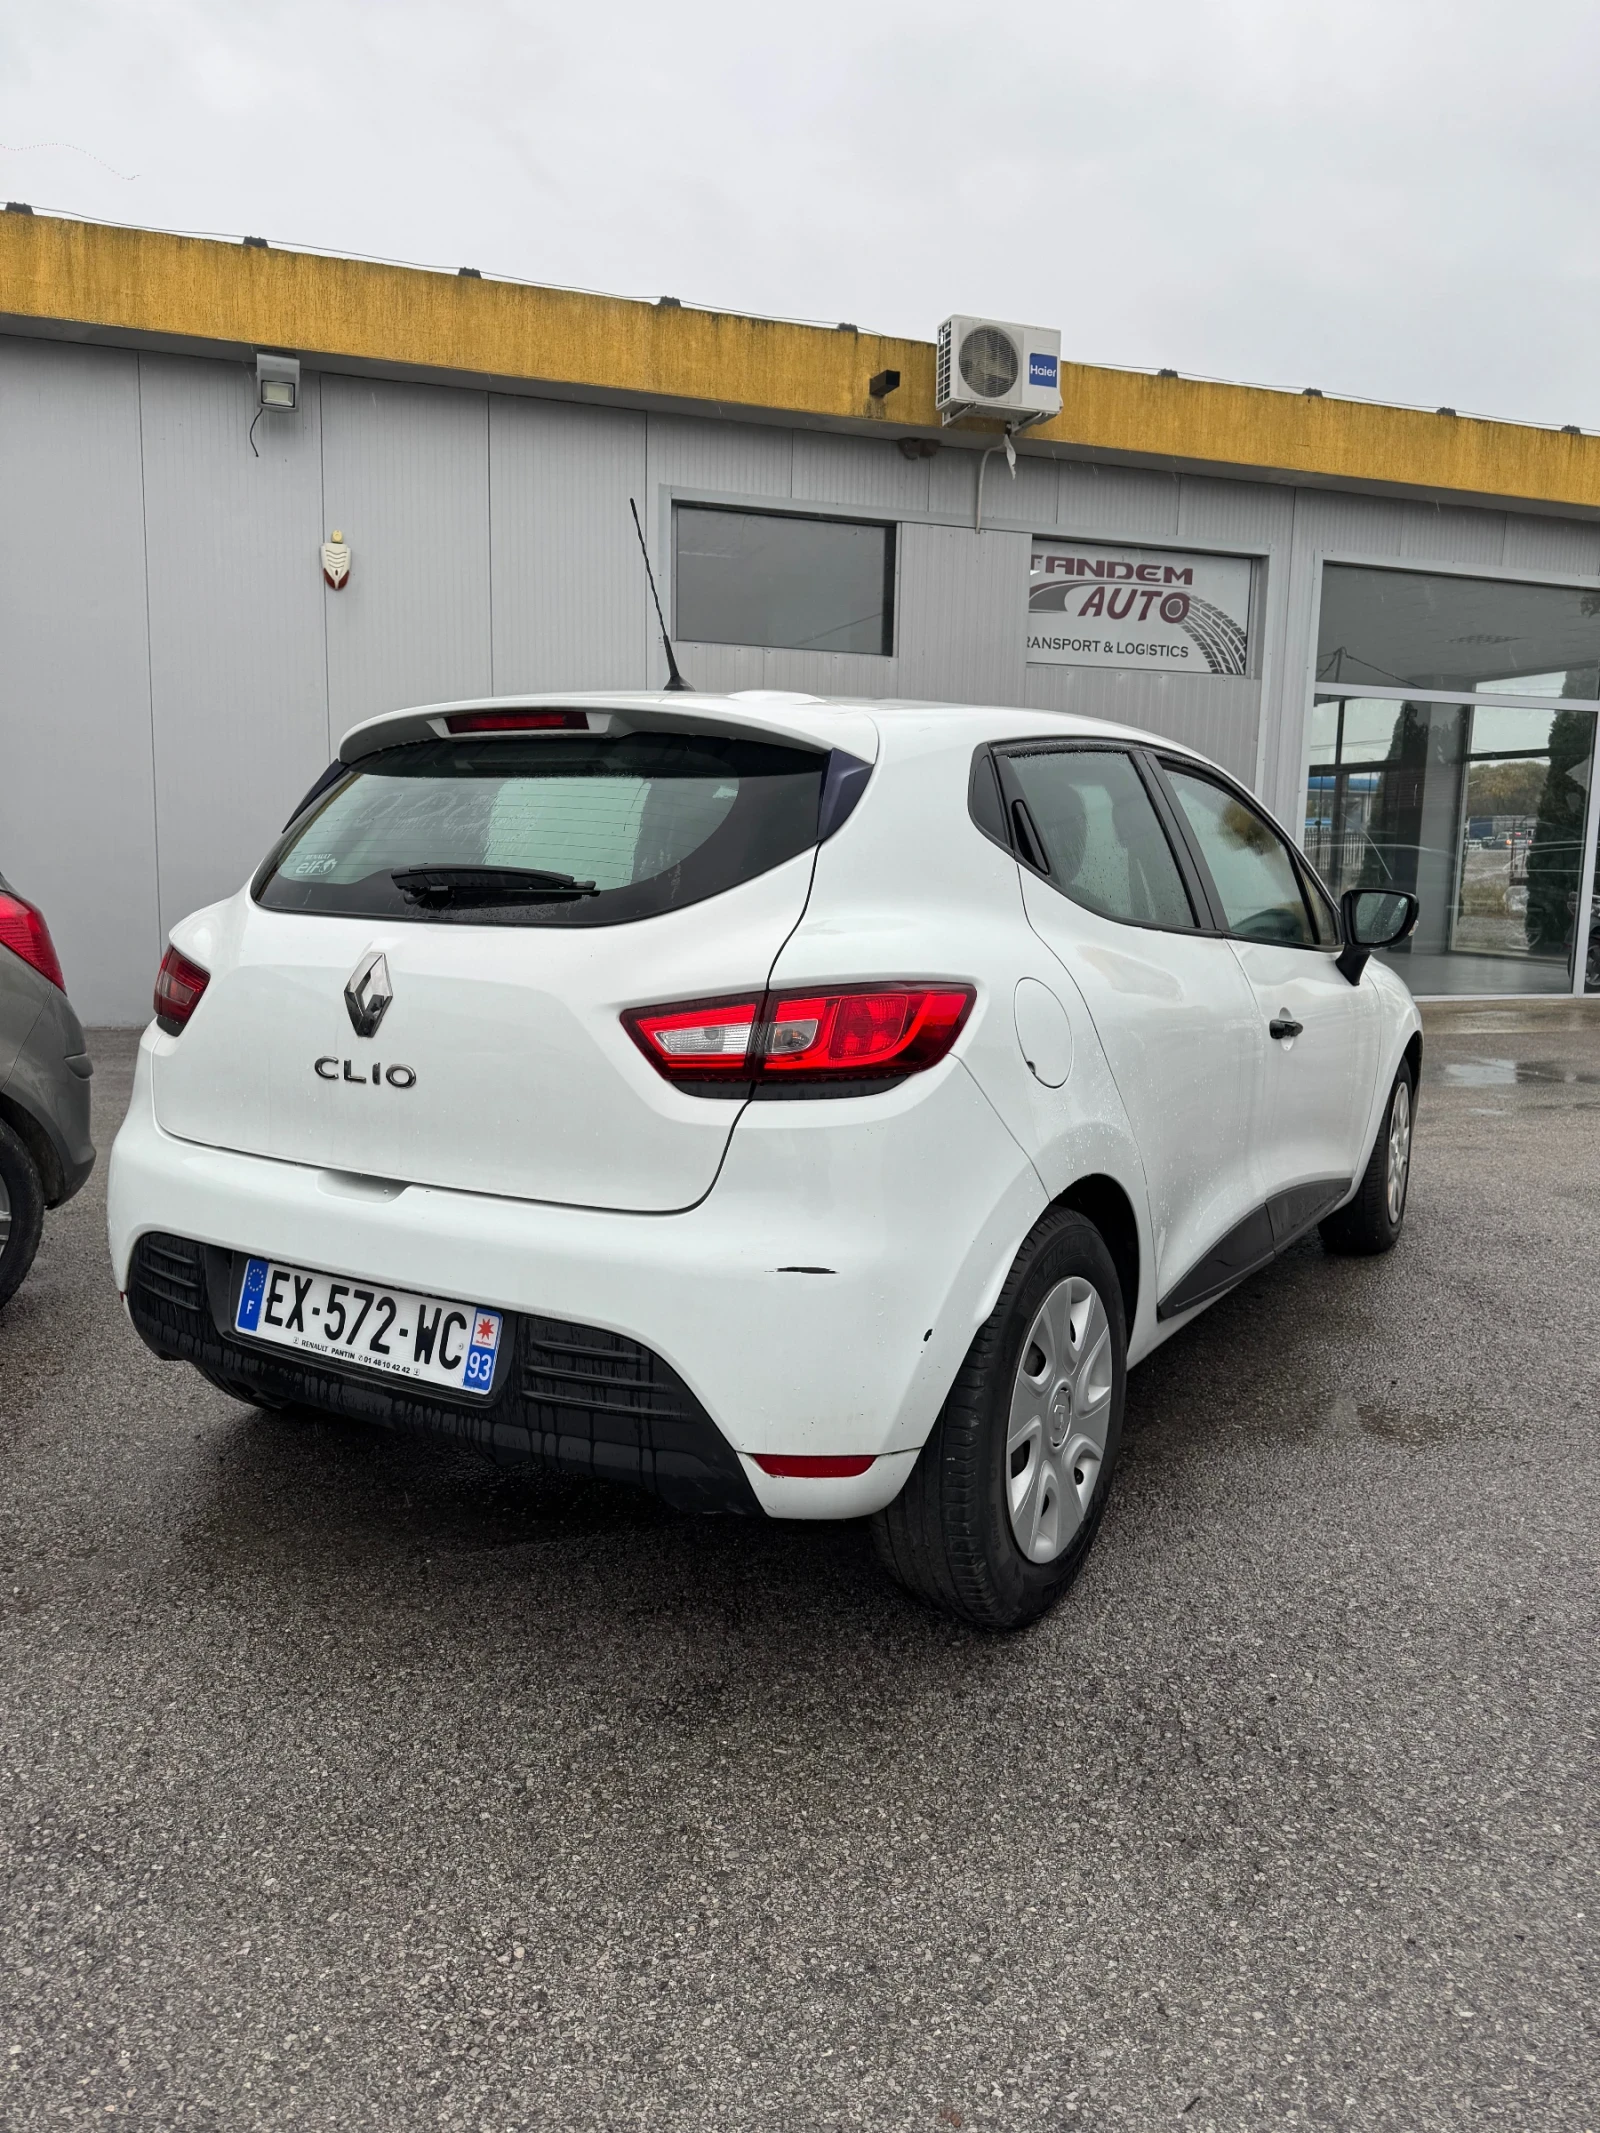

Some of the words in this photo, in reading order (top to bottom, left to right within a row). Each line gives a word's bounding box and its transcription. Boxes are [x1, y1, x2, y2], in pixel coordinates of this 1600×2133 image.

[1030, 364, 1057, 378] Haier
[1030, 554, 1194, 586] TANDEM
[1077, 586, 1190, 624] AUTO
[1103, 641, 1114, 653] &
[1116, 642, 1189, 658] LOGISTICS
[314, 1056, 417, 1089] CLIO
[245, 1300, 255, 1315] F
[264, 1269, 468, 1370] EX-572-WC
[301, 1339, 328, 1353] RENAULT
[331, 1347, 355, 1360] PANTIN
[467, 1351, 492, 1381] 93
